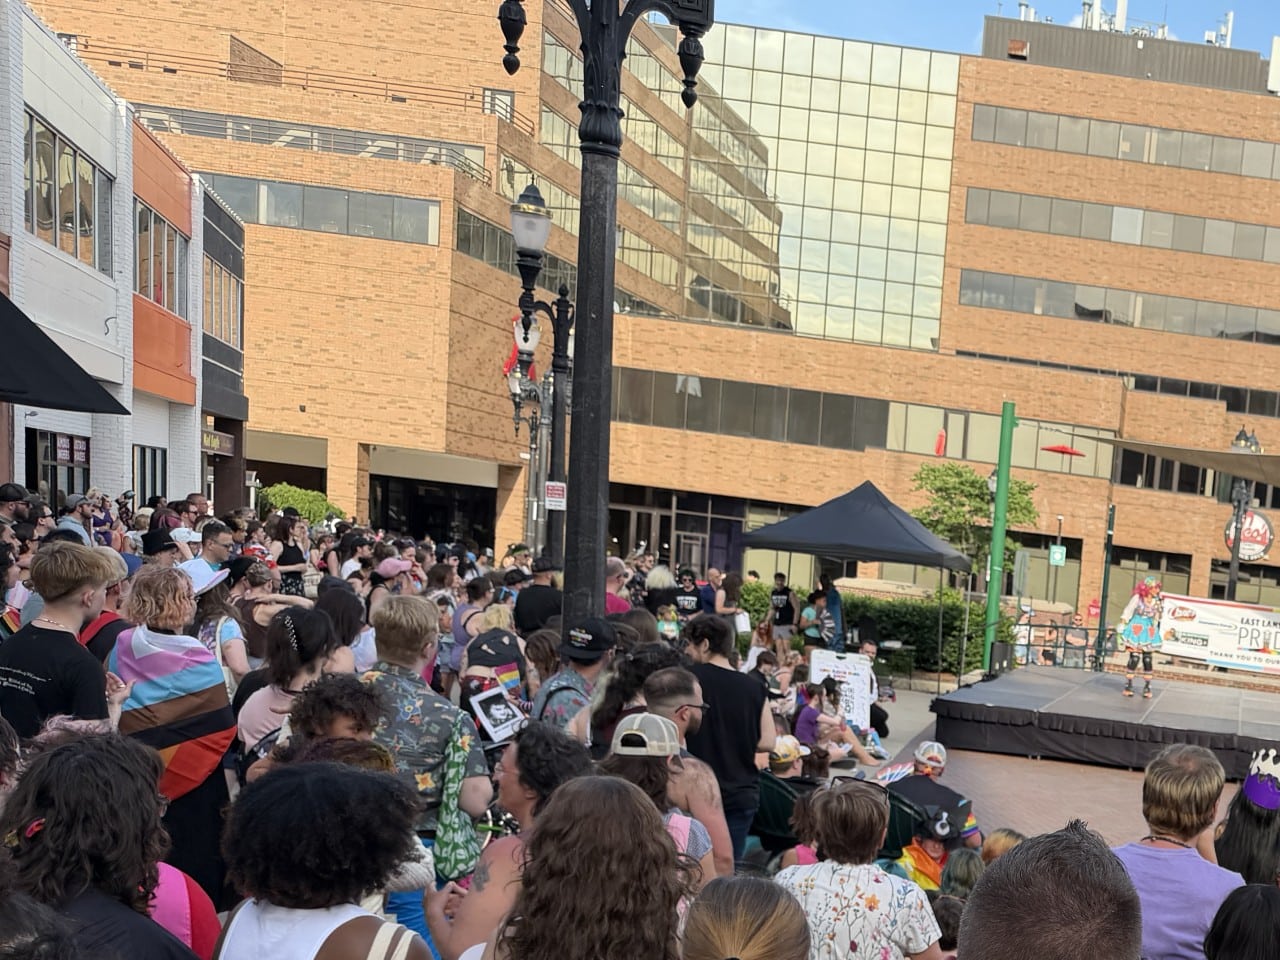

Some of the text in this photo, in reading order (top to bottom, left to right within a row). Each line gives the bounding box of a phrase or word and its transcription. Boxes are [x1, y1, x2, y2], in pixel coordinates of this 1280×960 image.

[1240, 616, 1262, 627] EAST
[1210, 651, 1234, 661] THANK
[1236, 653, 1251, 662] YOU
[1253, 656, 1263, 664] TO
[1265, 657, 1280, 666] OUR
